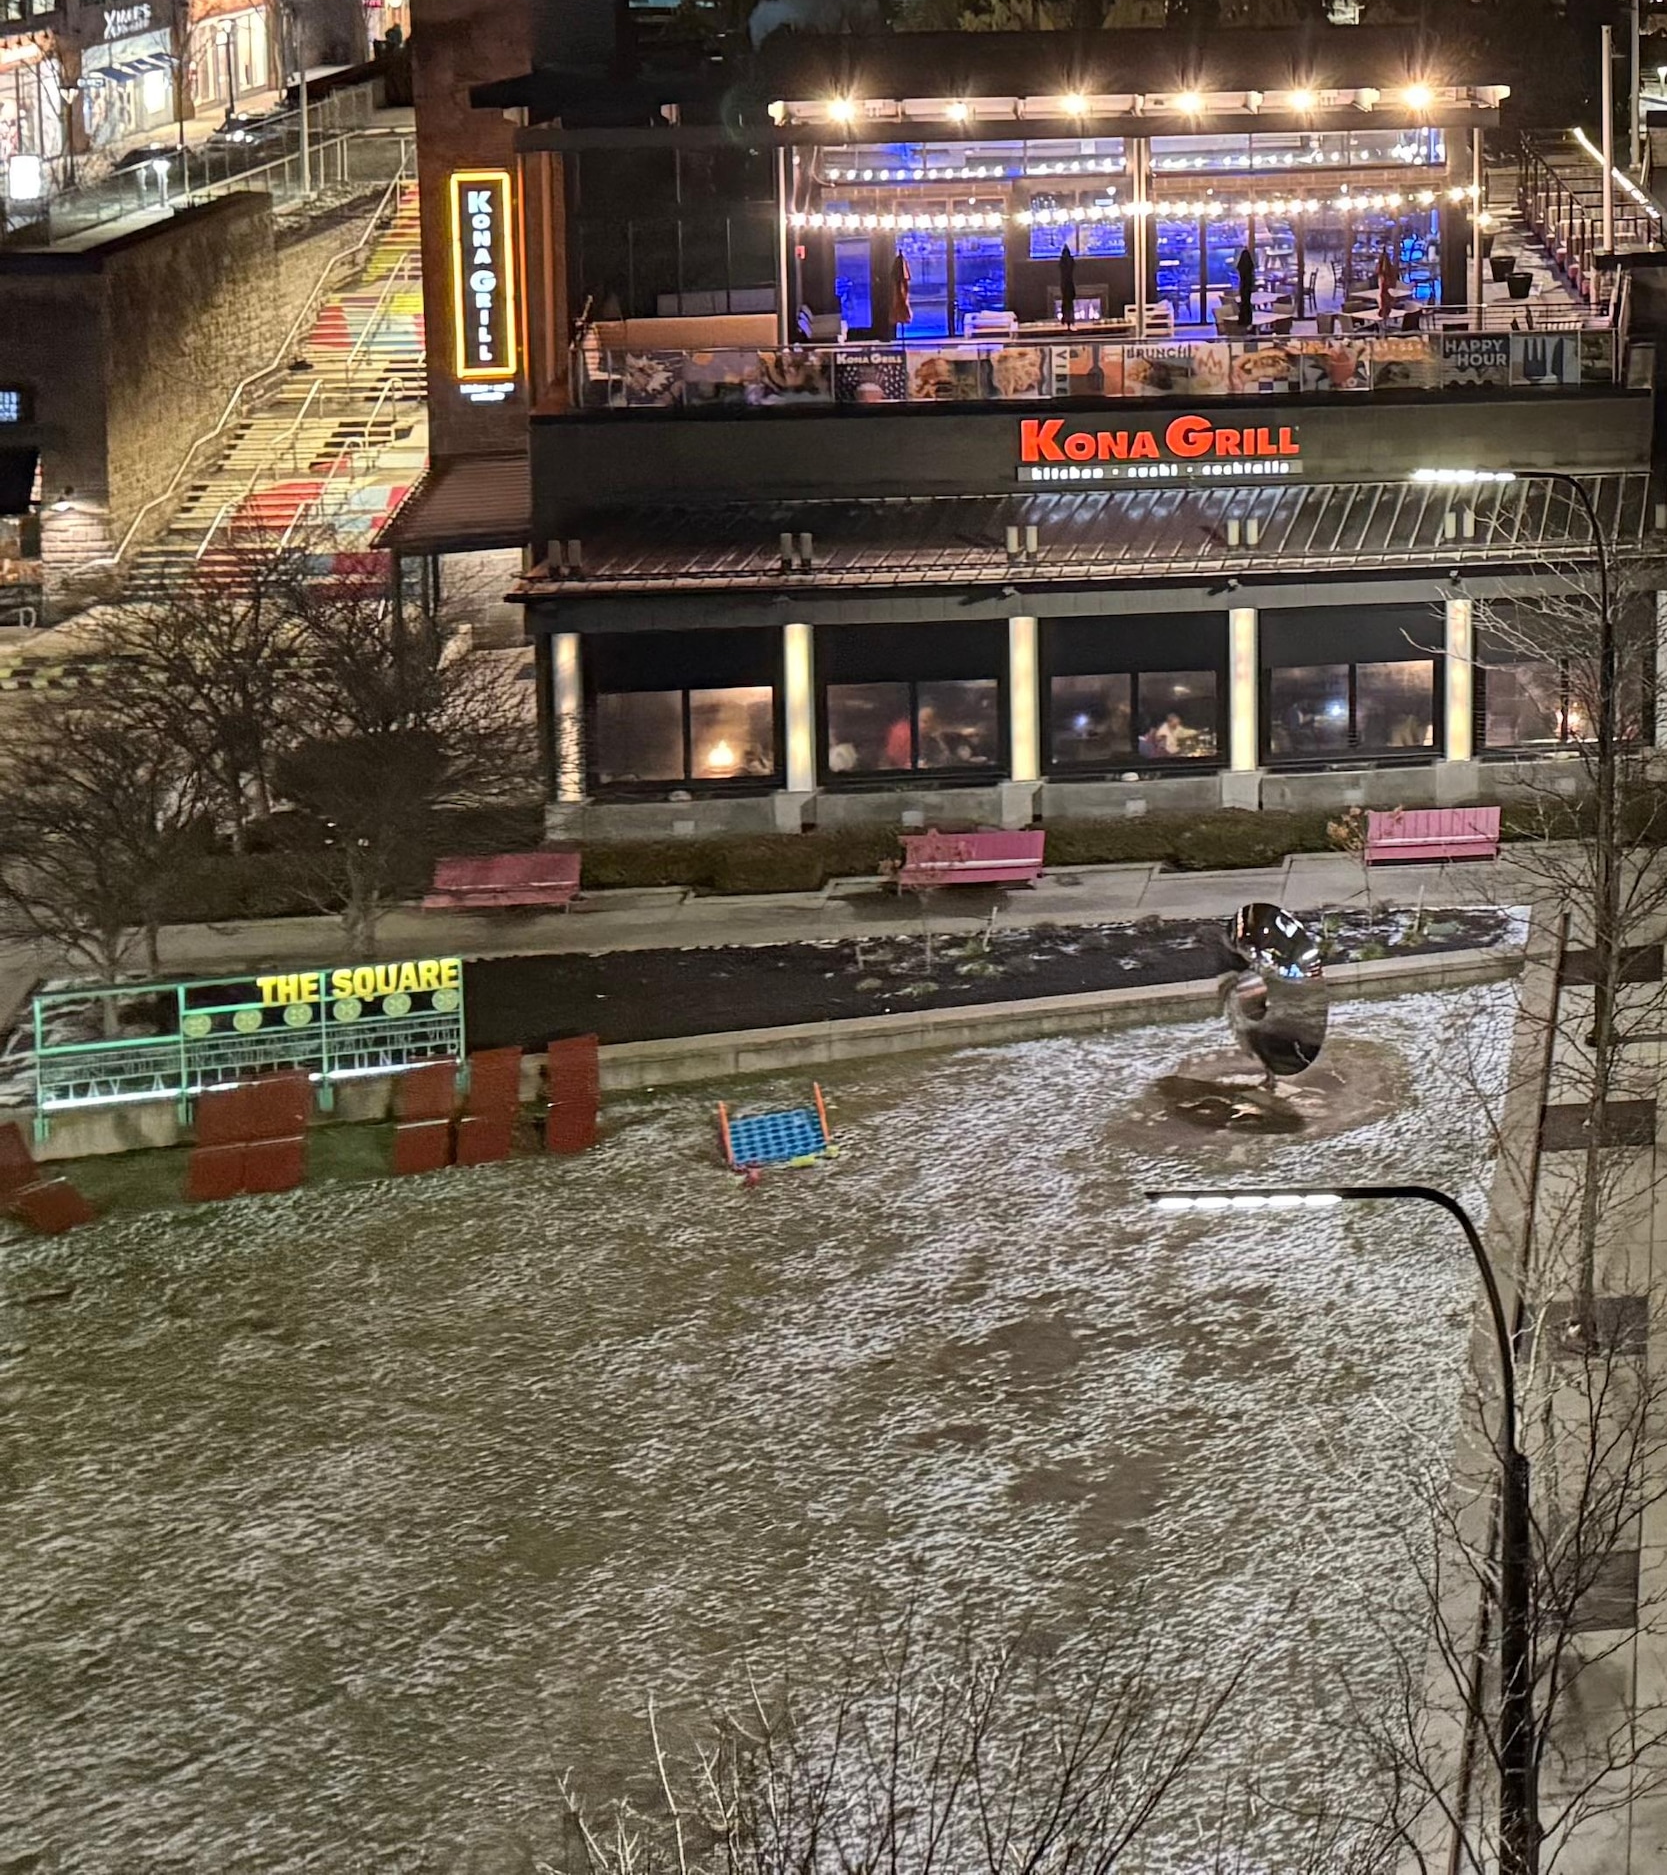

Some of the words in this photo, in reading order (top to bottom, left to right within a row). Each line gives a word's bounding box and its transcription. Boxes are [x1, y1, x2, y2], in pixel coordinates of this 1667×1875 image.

[1444, 338, 1505, 354] HAPPY
[1456, 351, 1508, 368] HOUR
[1020, 419, 1161, 462] KONA
[1165, 415, 1300, 458] GRILL
[256, 972, 321, 1007] THE
[331, 957, 461, 1002] SQUARE
